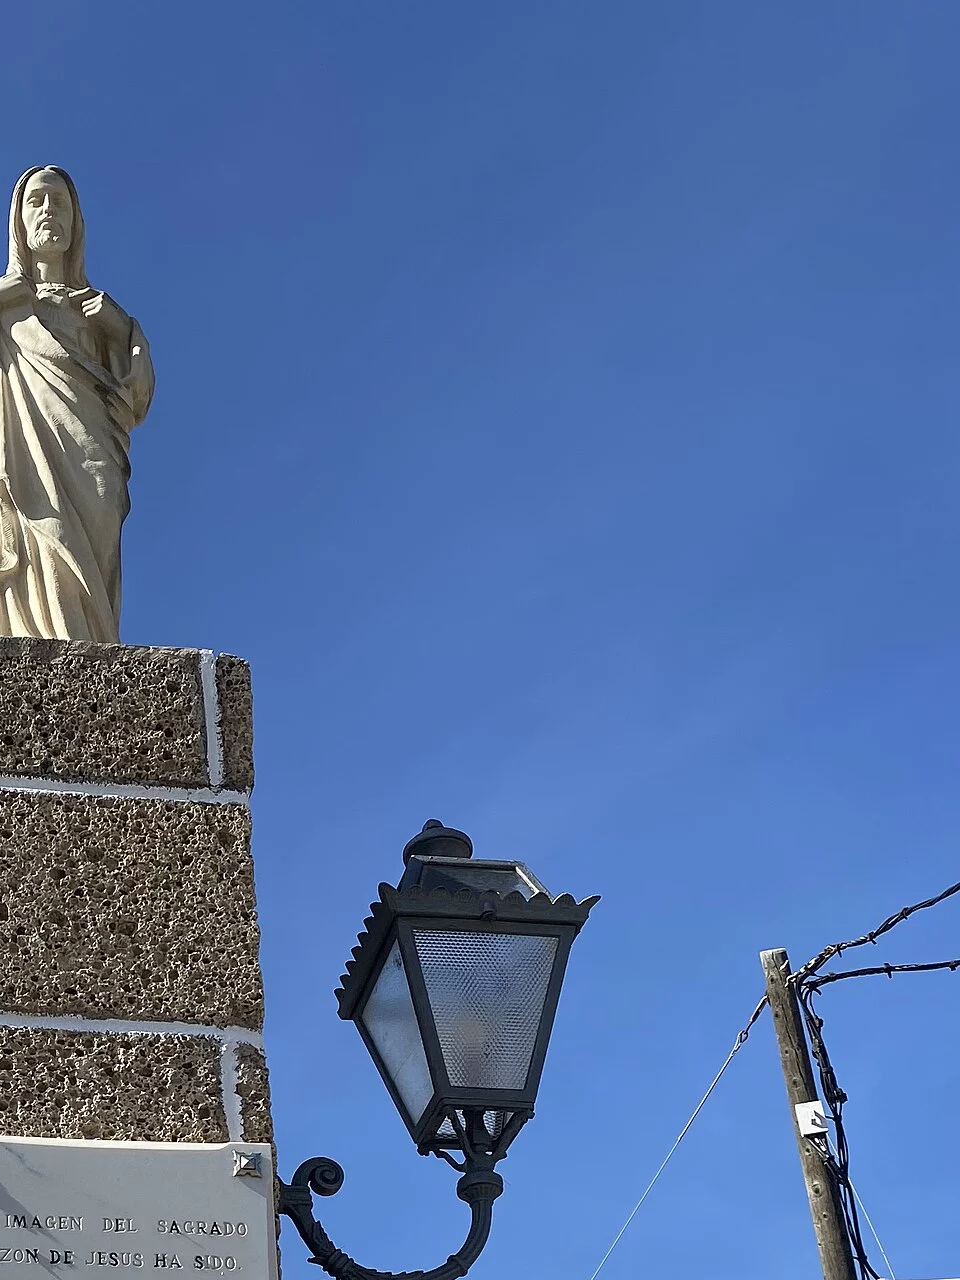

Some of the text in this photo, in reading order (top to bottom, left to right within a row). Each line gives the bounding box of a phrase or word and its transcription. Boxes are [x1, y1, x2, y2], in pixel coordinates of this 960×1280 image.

[5, 1214, 83, 1231] IMAGEN
[102, 1217, 138, 1234] DEL
[157, 1219, 248, 1237] SAGRADO
[49, 1249, 75, 1265] DE
[85, 1251, 144, 1267] JESUS
[154, 1254, 183, 1269] HA
